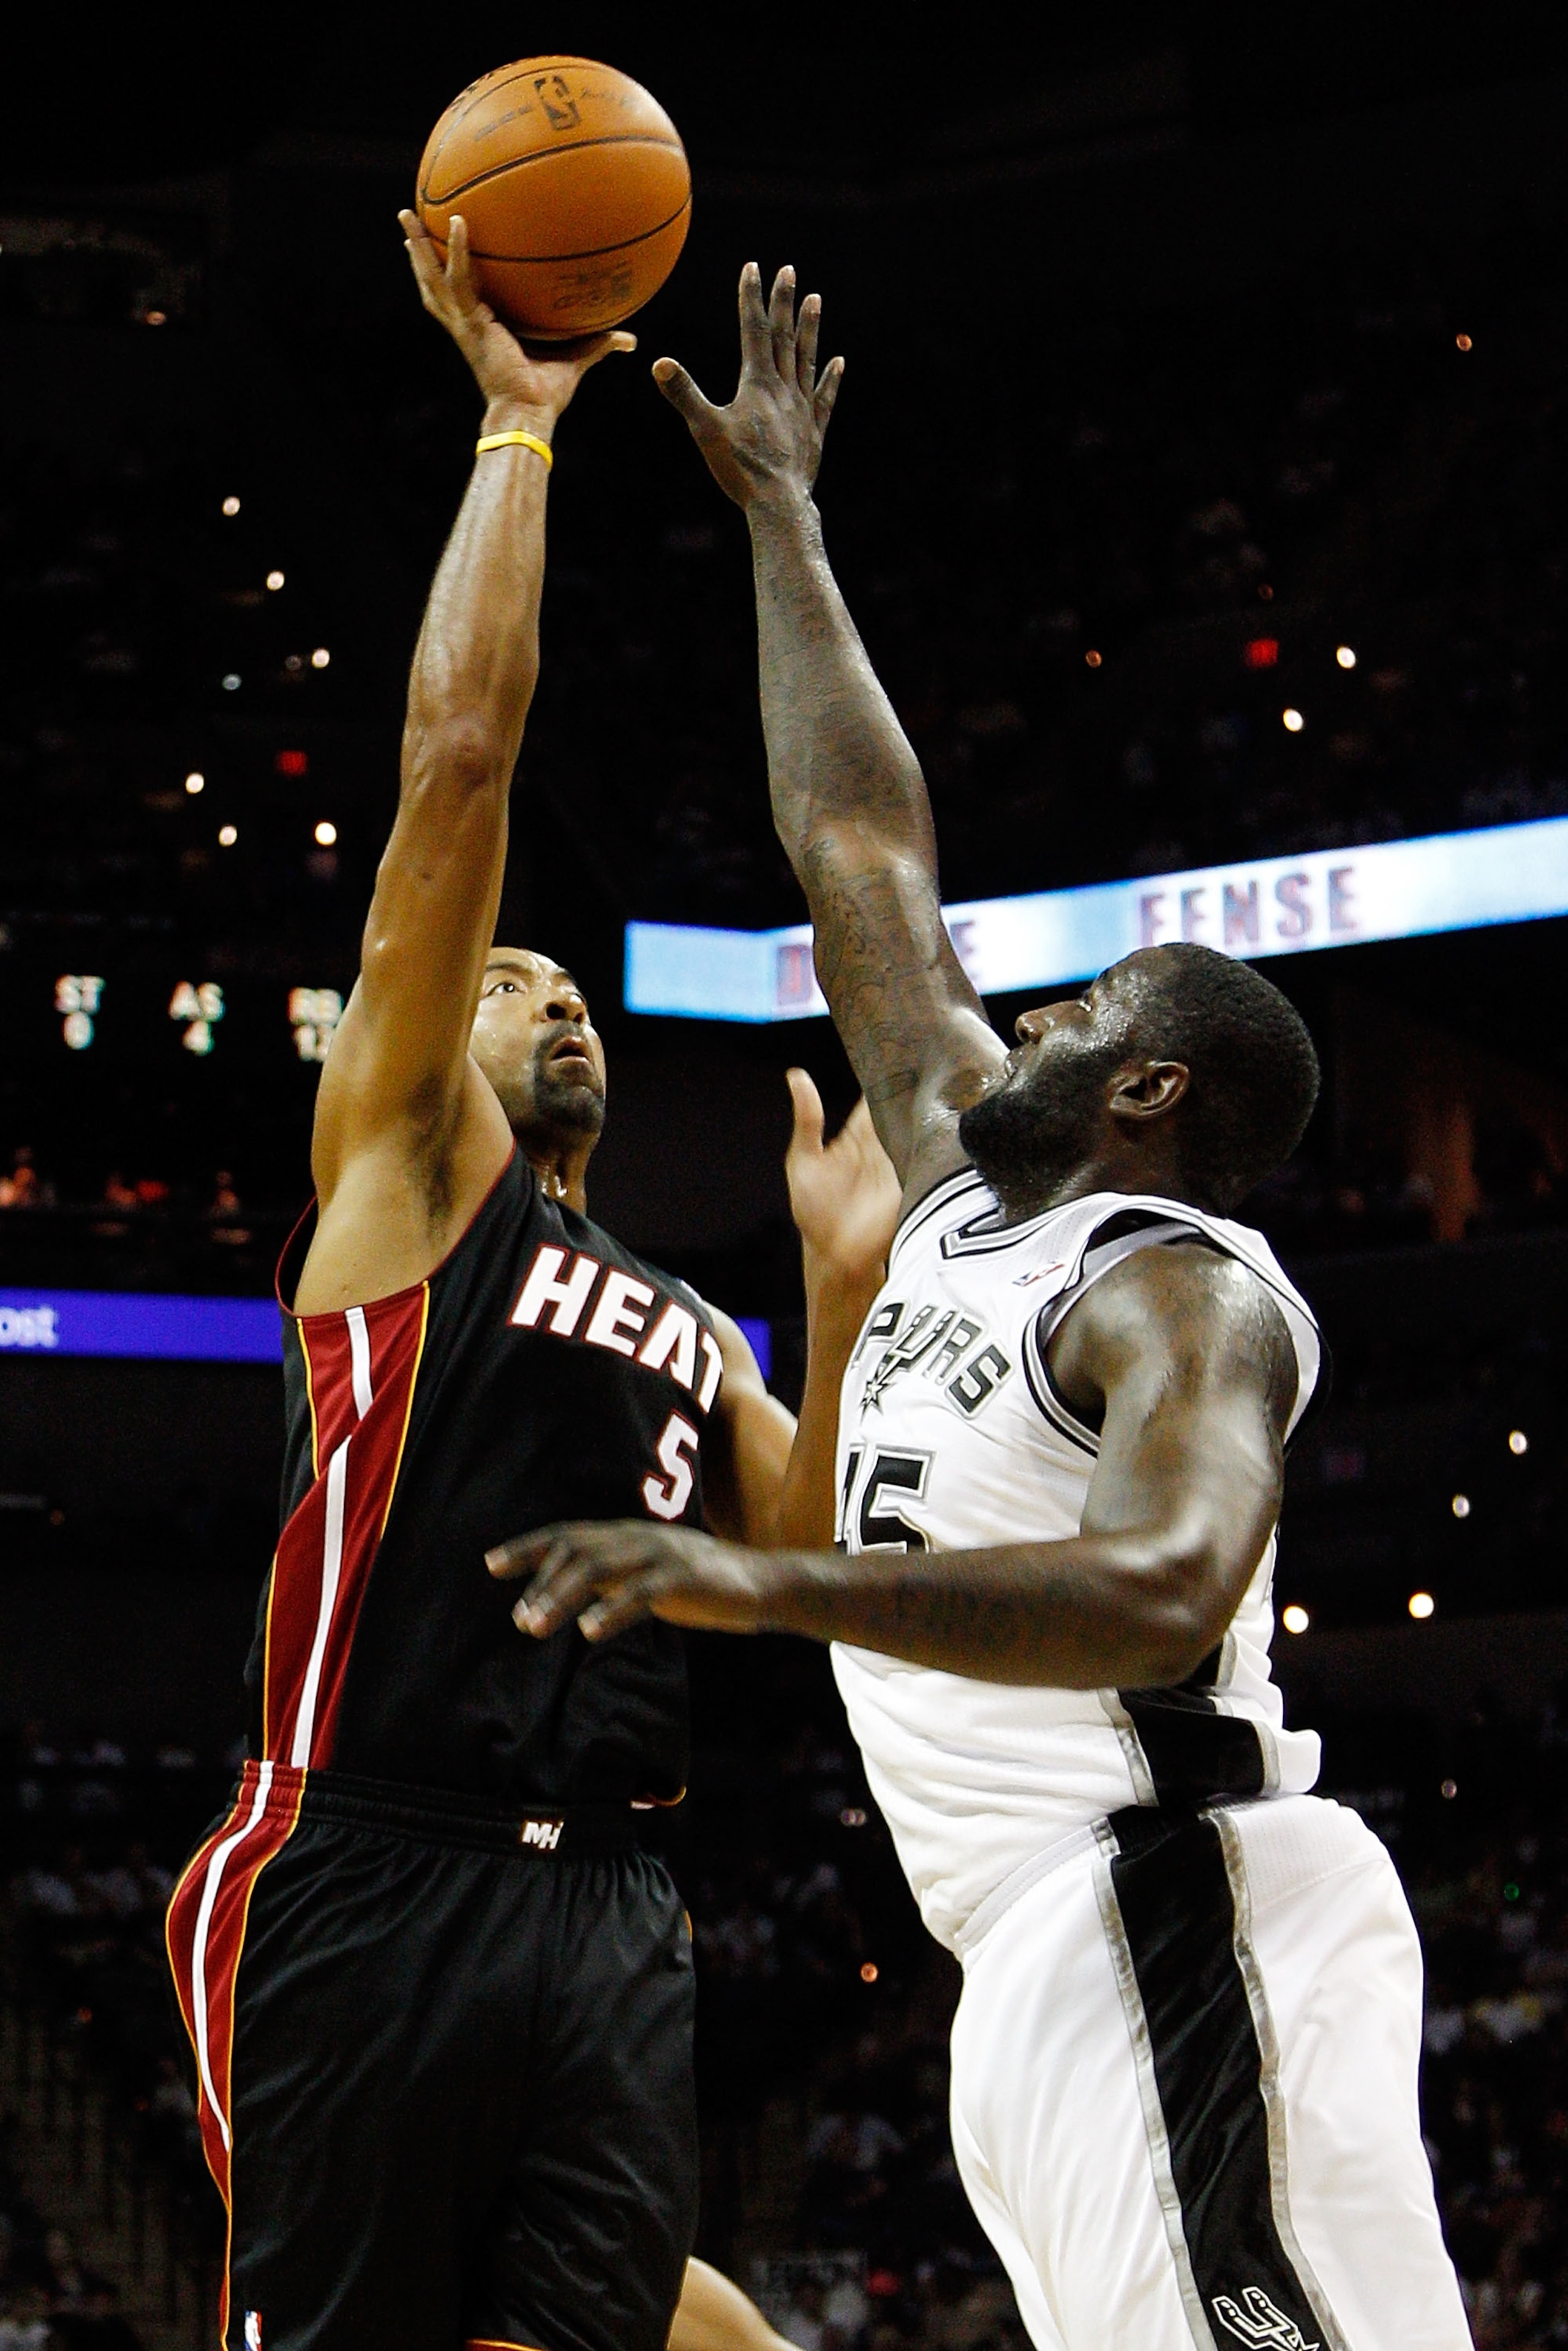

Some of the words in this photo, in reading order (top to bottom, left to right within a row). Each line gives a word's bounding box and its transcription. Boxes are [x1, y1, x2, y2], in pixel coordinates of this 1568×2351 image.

[55, 974, 105, 1014] ST
[168, 980, 225, 1022] AS
[507, 1242, 724, 1414] HEAT
[641, 1408, 700, 1522] 5
